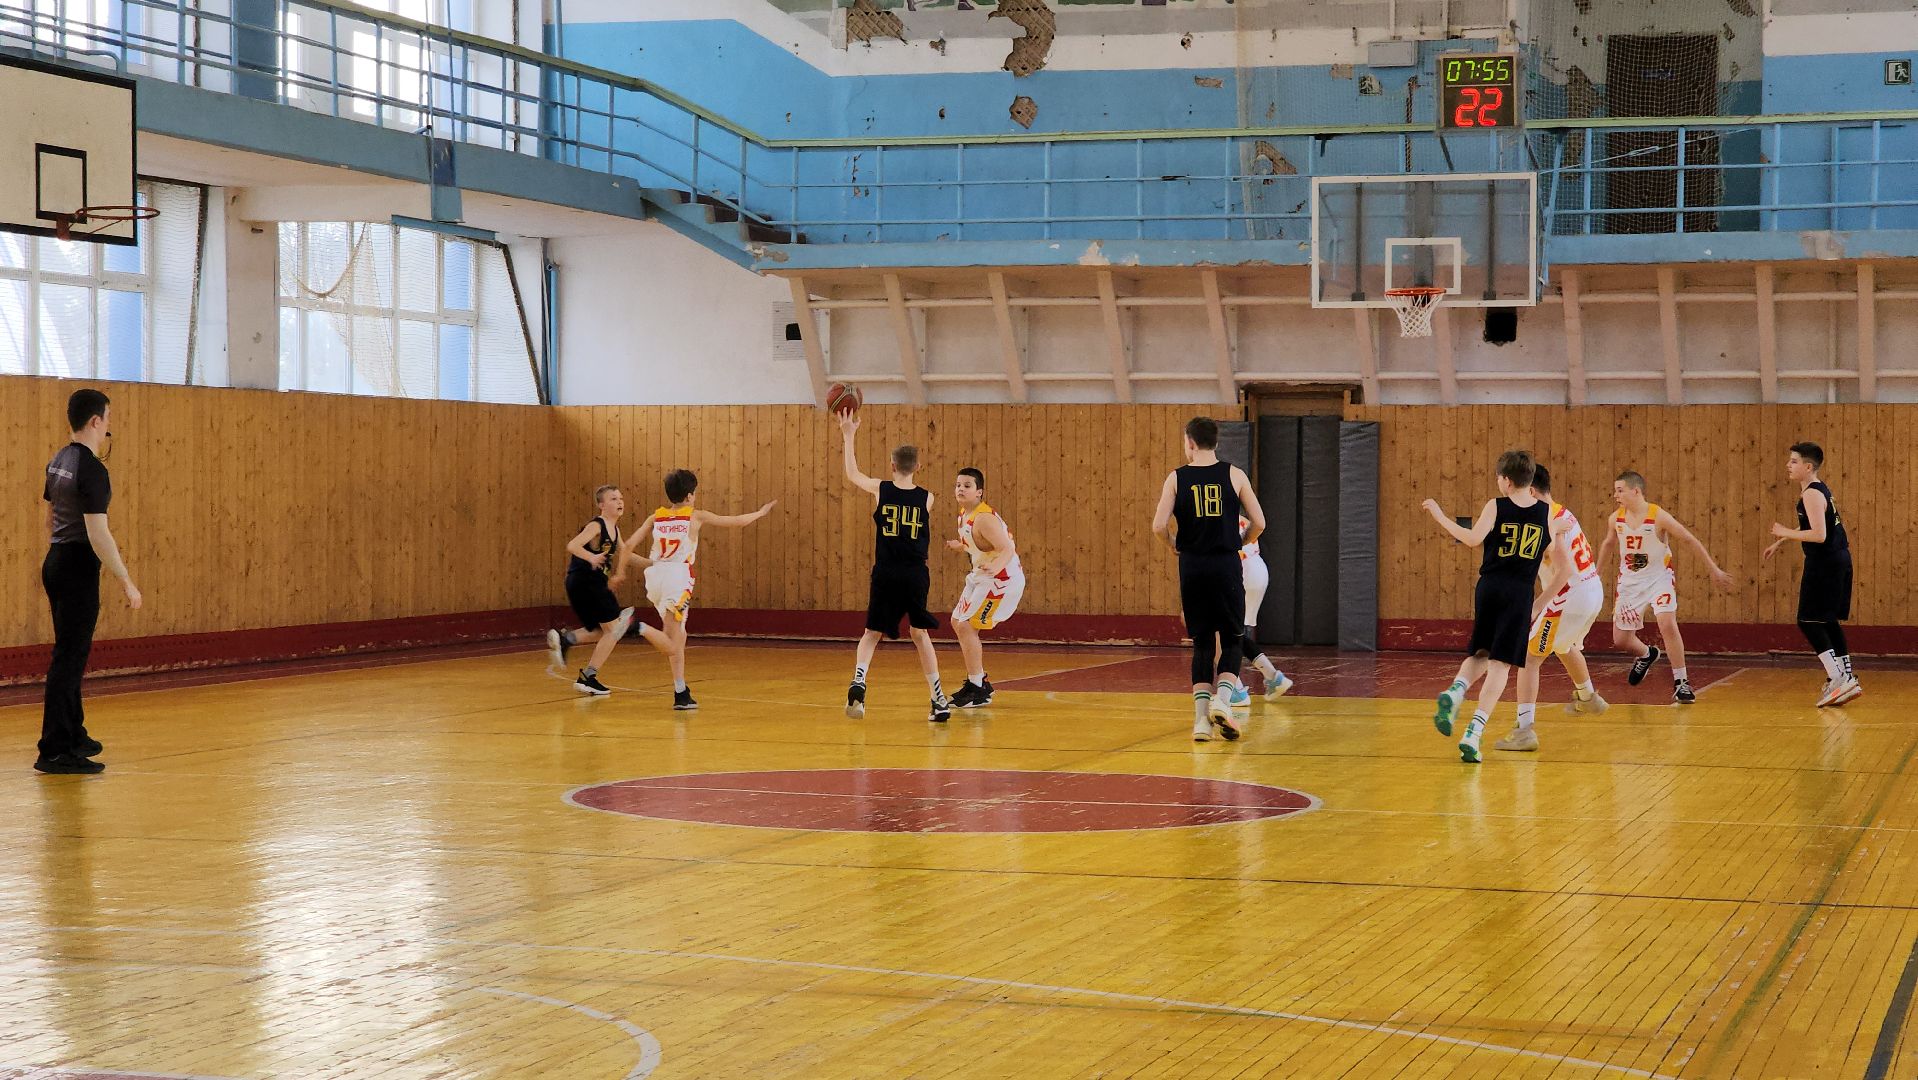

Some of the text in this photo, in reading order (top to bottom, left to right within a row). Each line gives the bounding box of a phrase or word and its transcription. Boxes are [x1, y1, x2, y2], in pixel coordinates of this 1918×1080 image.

[1446, 60, 1509, 82] 07:55
[1455, 87, 1503, 127] 22
[1190, 484, 1223, 518] 18
[881, 504, 923, 540] 34
[658, 537, 682, 559] 17
[1498, 523, 1544, 560] 30
[1625, 535, 1643, 550] 27
[1656, 593, 1672, 606] 27
